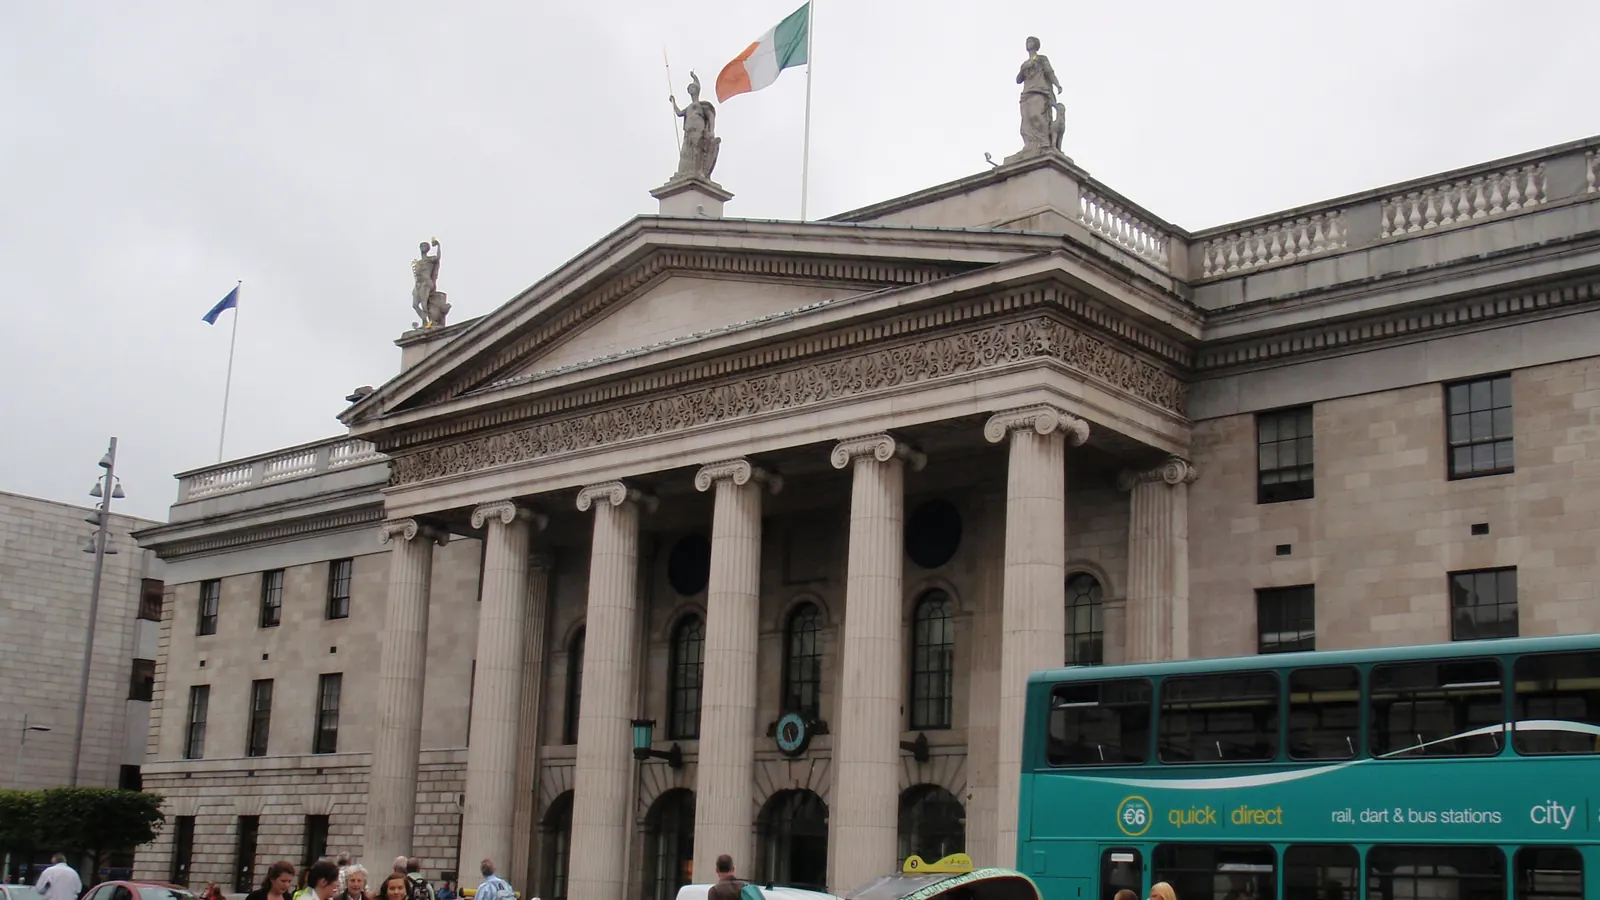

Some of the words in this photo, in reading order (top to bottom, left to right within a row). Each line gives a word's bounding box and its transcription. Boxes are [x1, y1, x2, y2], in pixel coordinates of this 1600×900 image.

[1123, 808, 1145, 825] €6
[1168, 805, 1217, 828] quick
[1231, 805, 1283, 825] direct
[1331, 808, 1355, 824] rail,
[1359, 808, 1389, 823] dart
[1393, 808, 1404, 823] &
[1408, 808, 1437, 824] bus
[1440, 808, 1502, 824] stations
[1530, 799, 1576, 830] city
